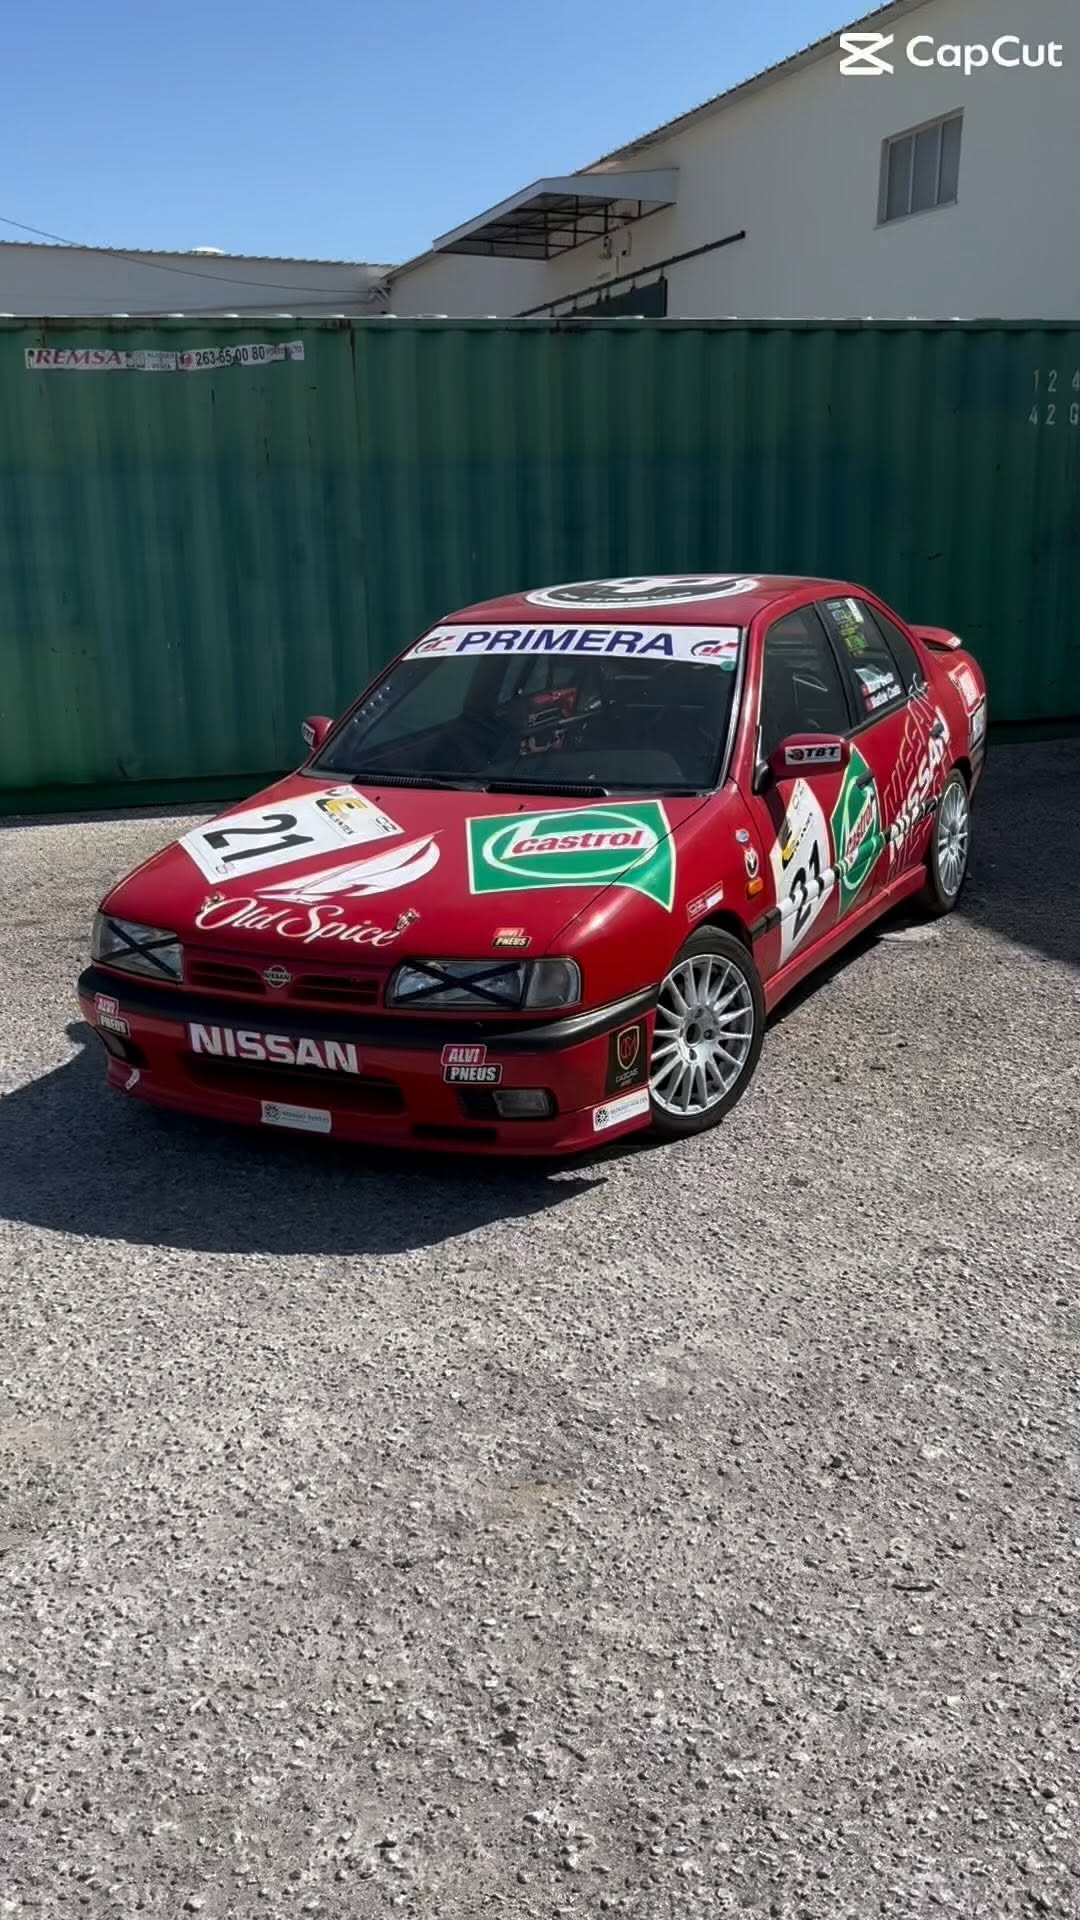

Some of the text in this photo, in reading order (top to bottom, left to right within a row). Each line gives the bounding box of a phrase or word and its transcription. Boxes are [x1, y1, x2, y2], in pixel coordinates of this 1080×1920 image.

[35, 350, 122, 364] REMSA
[251, 346, 266, 360] 80
[456, 629, 674, 656] PRIMERA
[805, 746, 839, 757] TBT
[203, 813, 314, 864] 21
[791, 840, 823, 940] 21
[195, 897, 400, 946] Old Spice
[496, 937, 527, 946] PNEUS
[263, 972, 292, 981] NISSAN
[188, 1022, 360, 1074] NISSAN
[449, 1048, 480, 1062] ALVI
[450, 1066, 497, 1081] PNEUS
